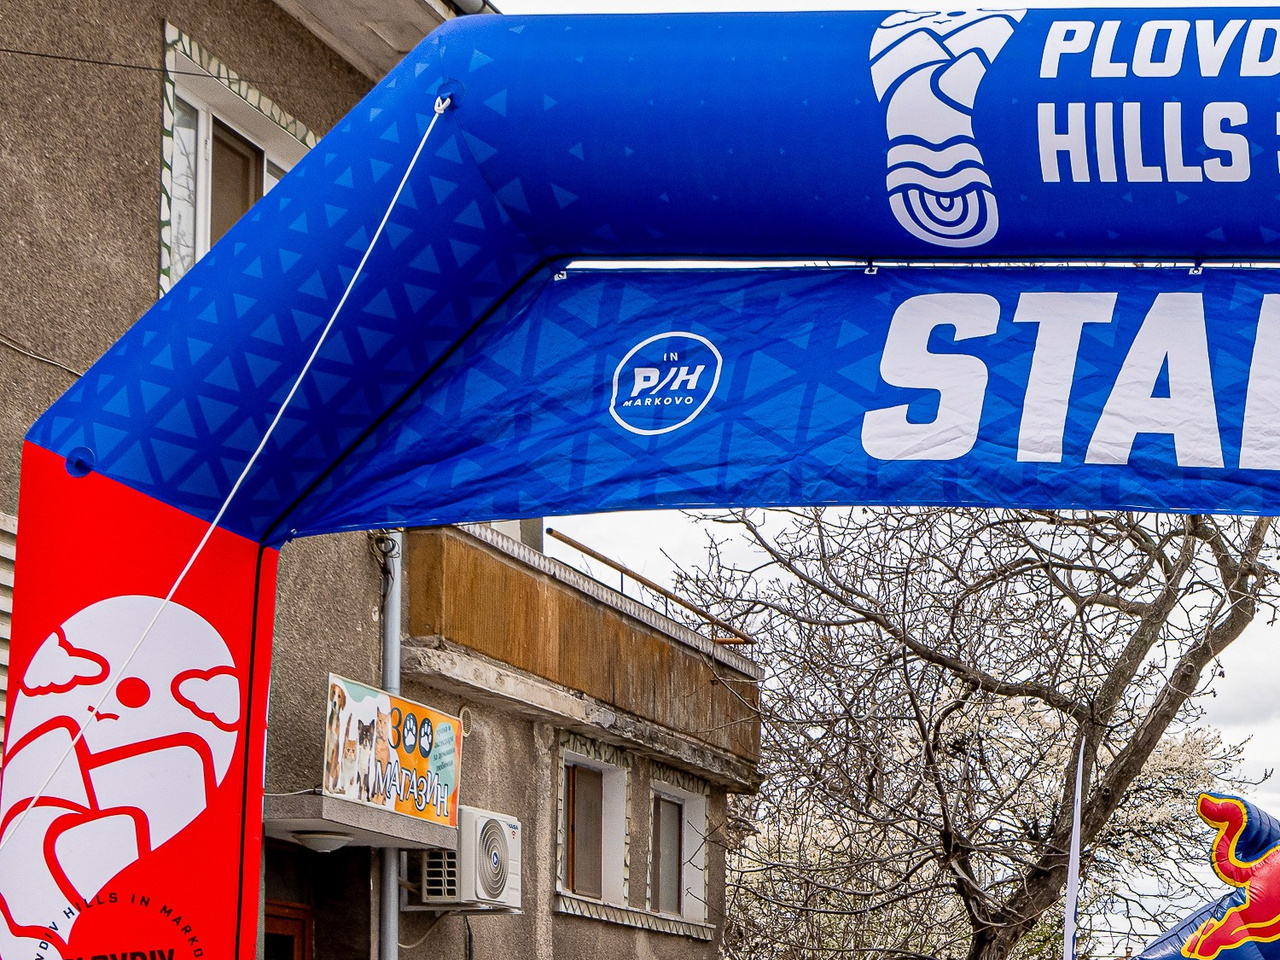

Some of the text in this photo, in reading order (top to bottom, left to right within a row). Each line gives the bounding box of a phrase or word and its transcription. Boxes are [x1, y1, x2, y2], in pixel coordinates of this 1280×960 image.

[1037, 101, 1250, 183] HILLS
[663, 352, 679, 362] IN
[630, 365, 705, 397] P/H
[622, 396, 694, 407] MARKOVO
[374, 759, 449, 818] МАГАЗИН
[63, 892, 119, 920] HILLS
[130, 893, 151, 908] IN
